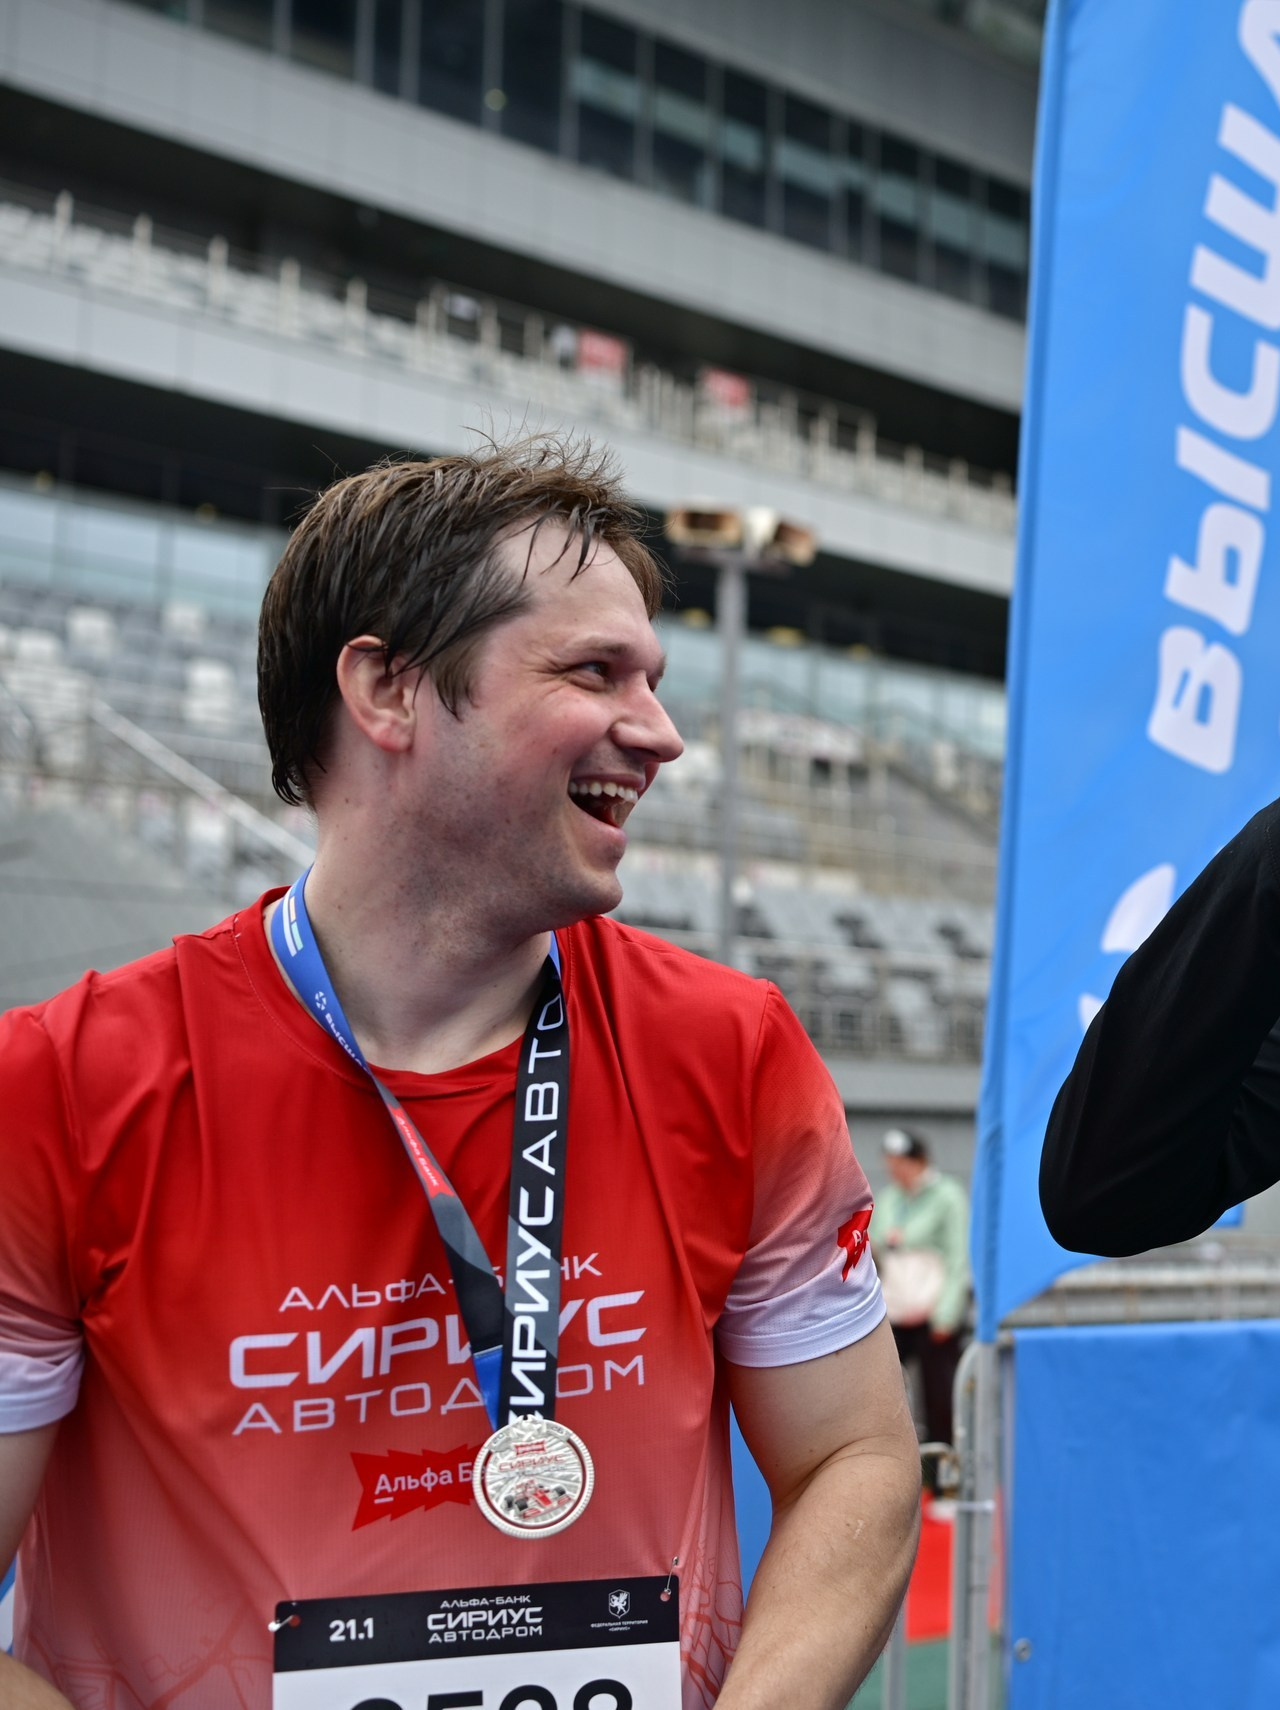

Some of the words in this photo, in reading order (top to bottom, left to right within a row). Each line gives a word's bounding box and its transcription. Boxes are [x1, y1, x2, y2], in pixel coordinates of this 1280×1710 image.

[395, 1114, 421, 1157] Альфа
[414, 1156, 439, 1188] Банк
[508, 1186, 554, 1426] ИРИУС
[232, 1354, 646, 1436] АВТОДОМ
[374, 1466, 454, 1500] Альфа
[440, 1595, 531, 1609] АЛЬФА-БАНК
[329, 1618, 374, 1642] 21.1
[427, 1606, 543, 1631] СИРИУС
[428, 1625, 542, 1644] АВТОДРОМ
